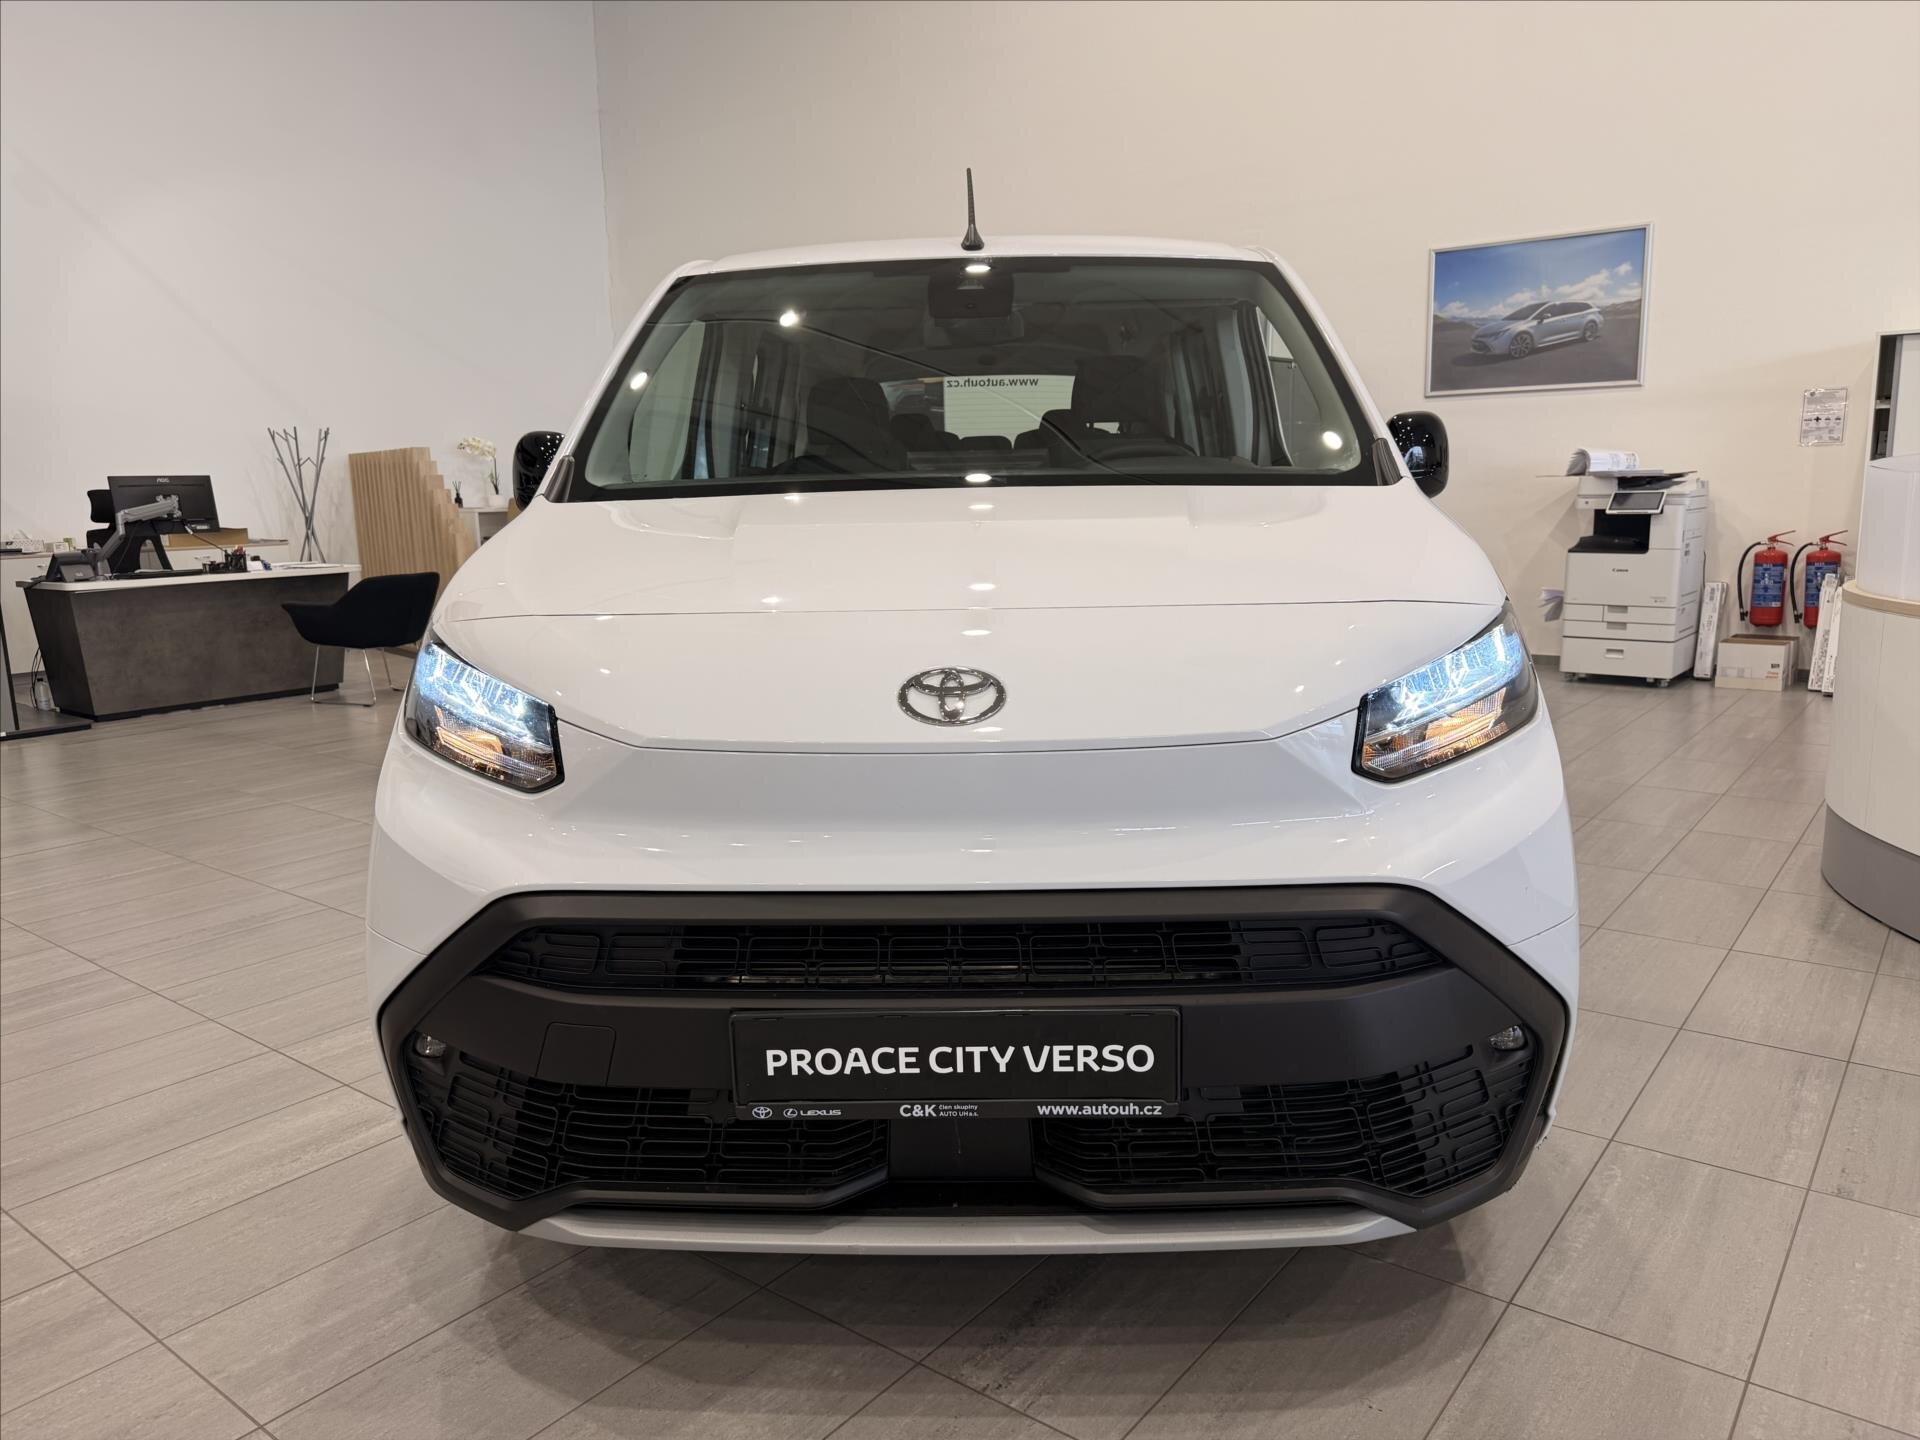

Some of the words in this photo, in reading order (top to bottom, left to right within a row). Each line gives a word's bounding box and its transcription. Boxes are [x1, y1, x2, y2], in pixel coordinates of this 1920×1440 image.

[766, 1047, 920, 1076] PROACE
[928, 1045, 1016, 1074] CITY
[1022, 1044, 1155, 1073] VERSO
[799, 1108, 842, 1117] LEXUS
[899, 1104, 937, 1118] C&K
[1037, 1102, 1163, 1116] www.autouh.cz
